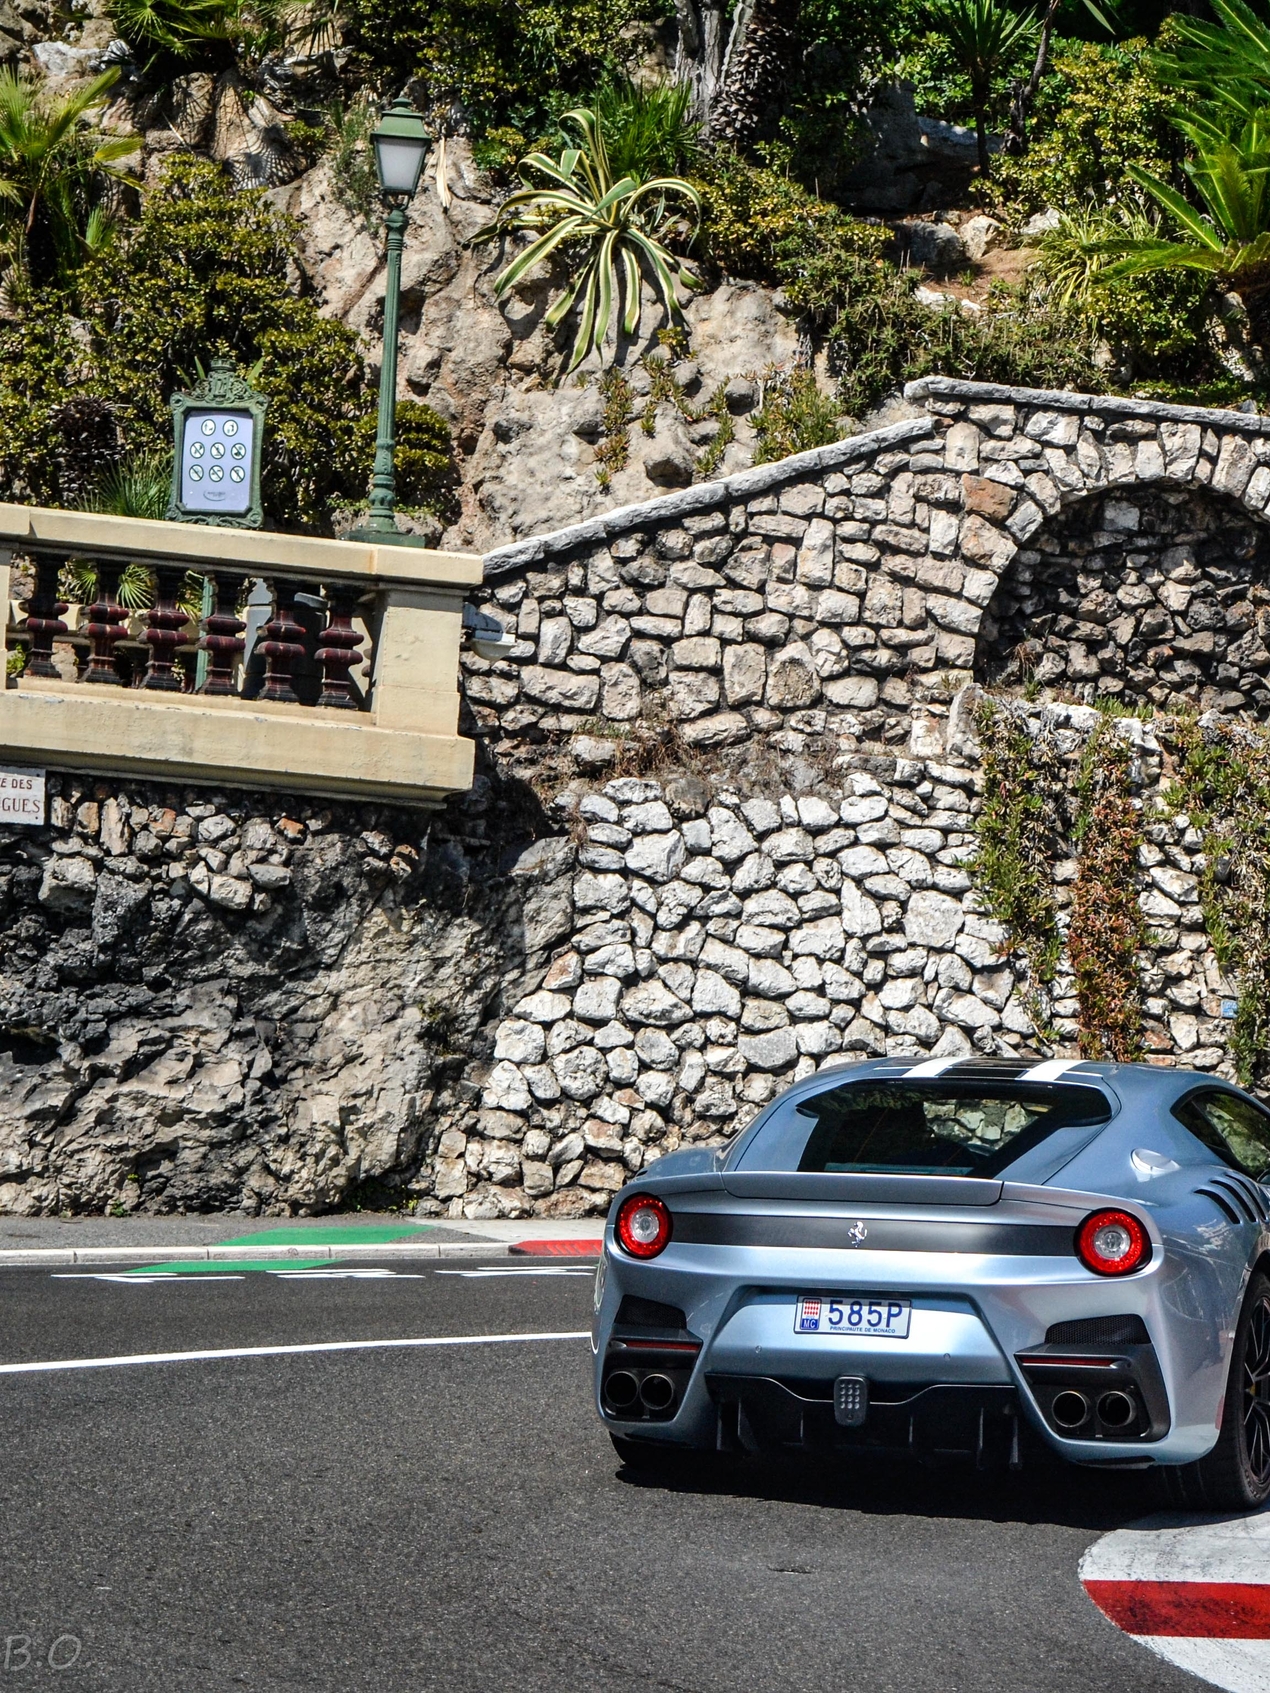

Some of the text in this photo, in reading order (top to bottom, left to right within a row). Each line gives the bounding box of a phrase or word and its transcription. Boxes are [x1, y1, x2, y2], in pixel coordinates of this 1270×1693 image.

[0, 778, 32, 790] E DES
[0, 797, 41, 813] GUES
[828, 1299, 903, 1328] 585P
[804, 1319, 816, 1328] MC
